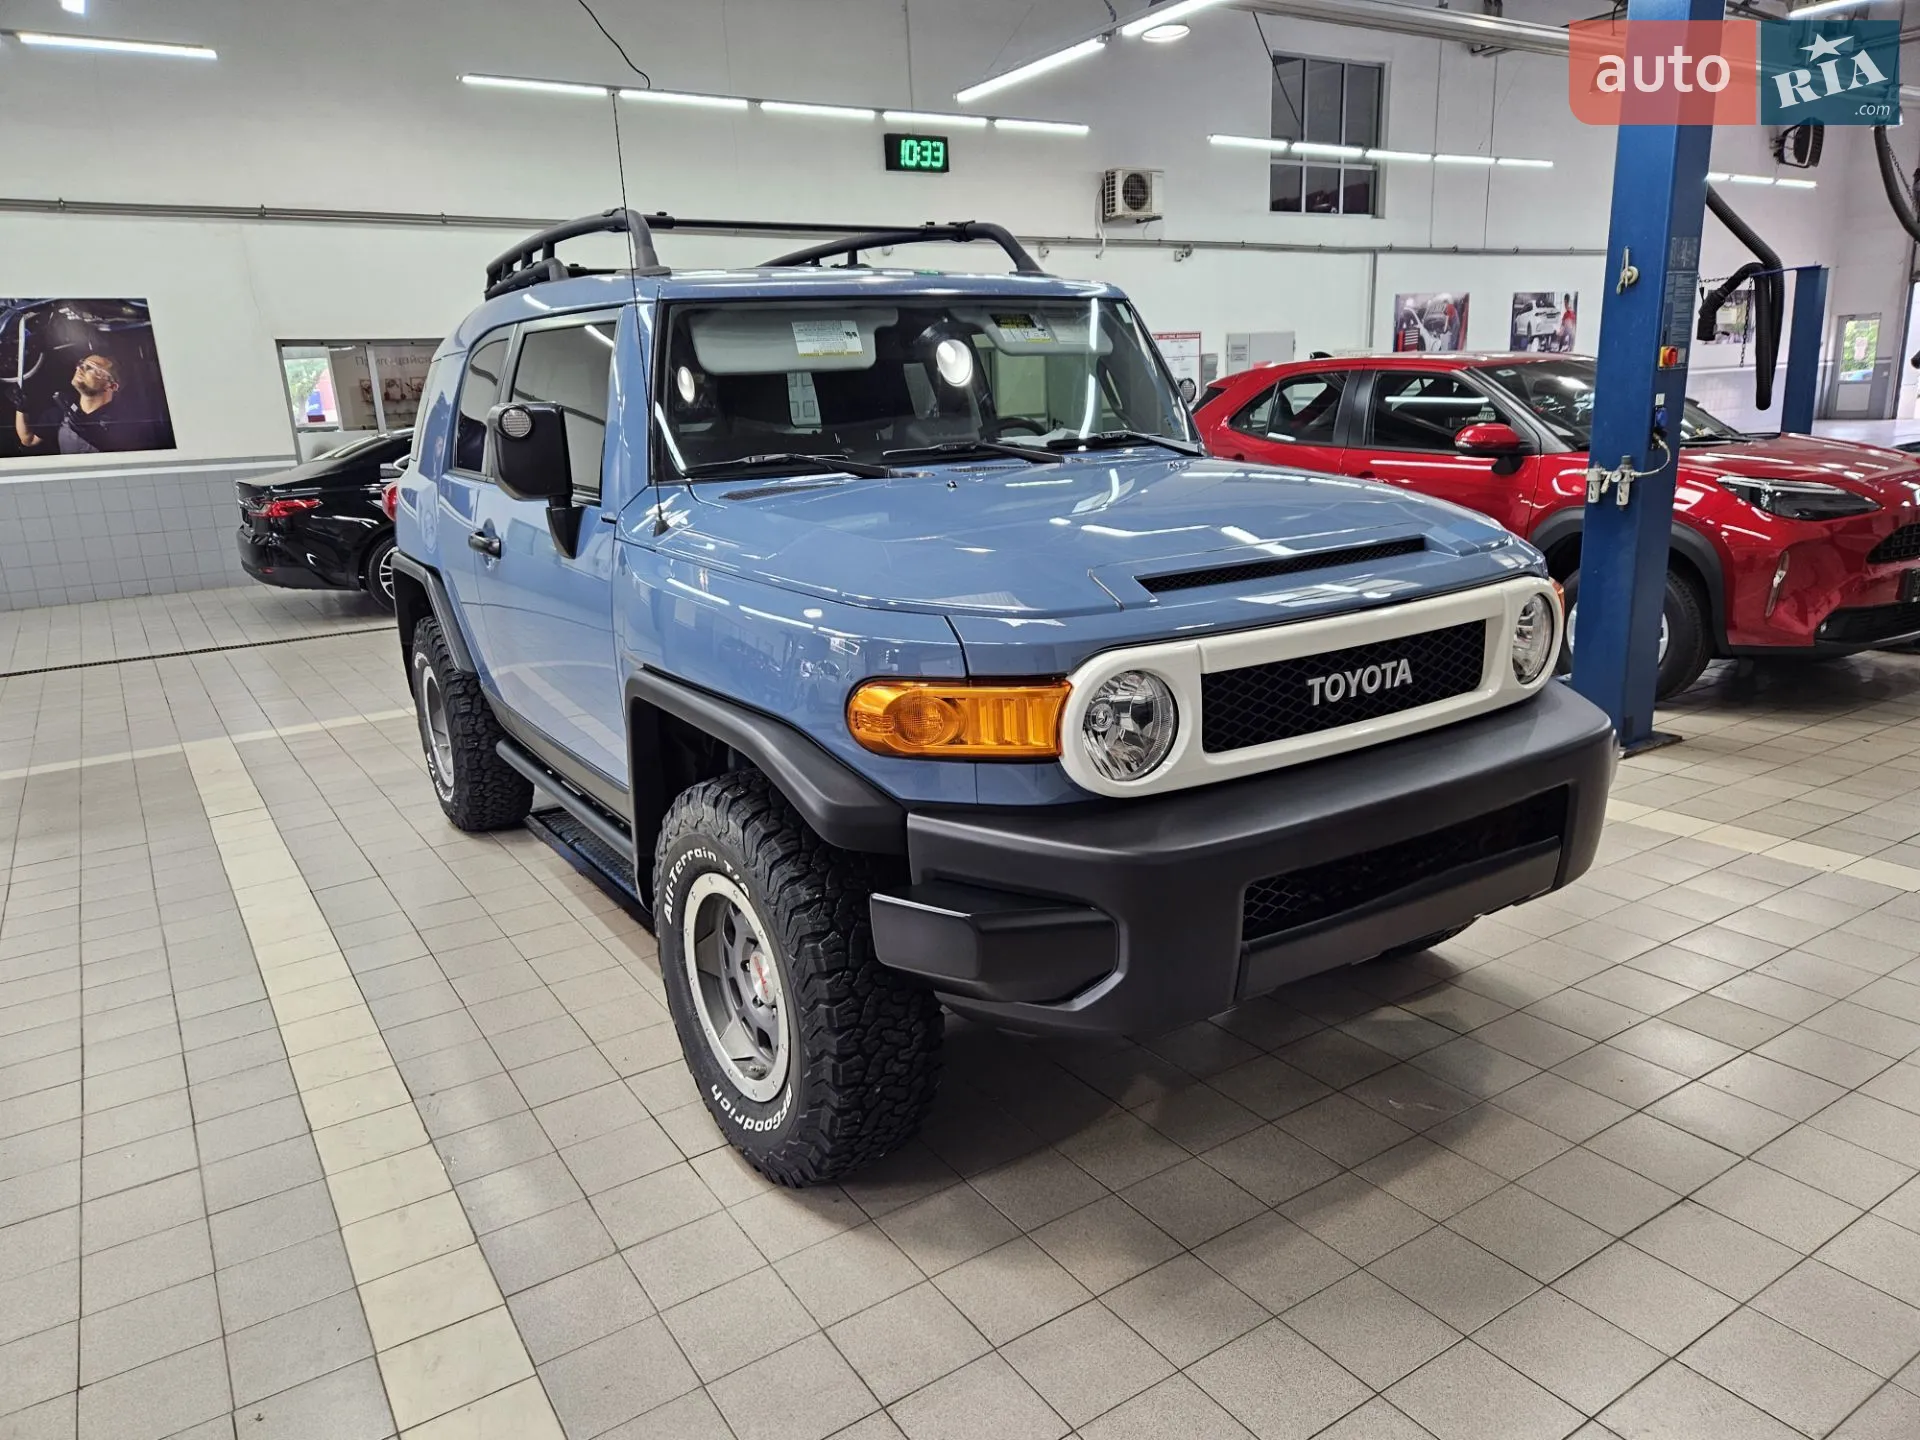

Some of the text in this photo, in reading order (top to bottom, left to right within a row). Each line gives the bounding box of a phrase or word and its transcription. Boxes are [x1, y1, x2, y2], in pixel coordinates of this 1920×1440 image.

[900, 139, 944, 168] 10:33
[1307, 658, 1413, 706] TOYOTA
[663, 846, 717, 926] All-Terrain
[711, 1082, 793, 1132] BFGoodrich
